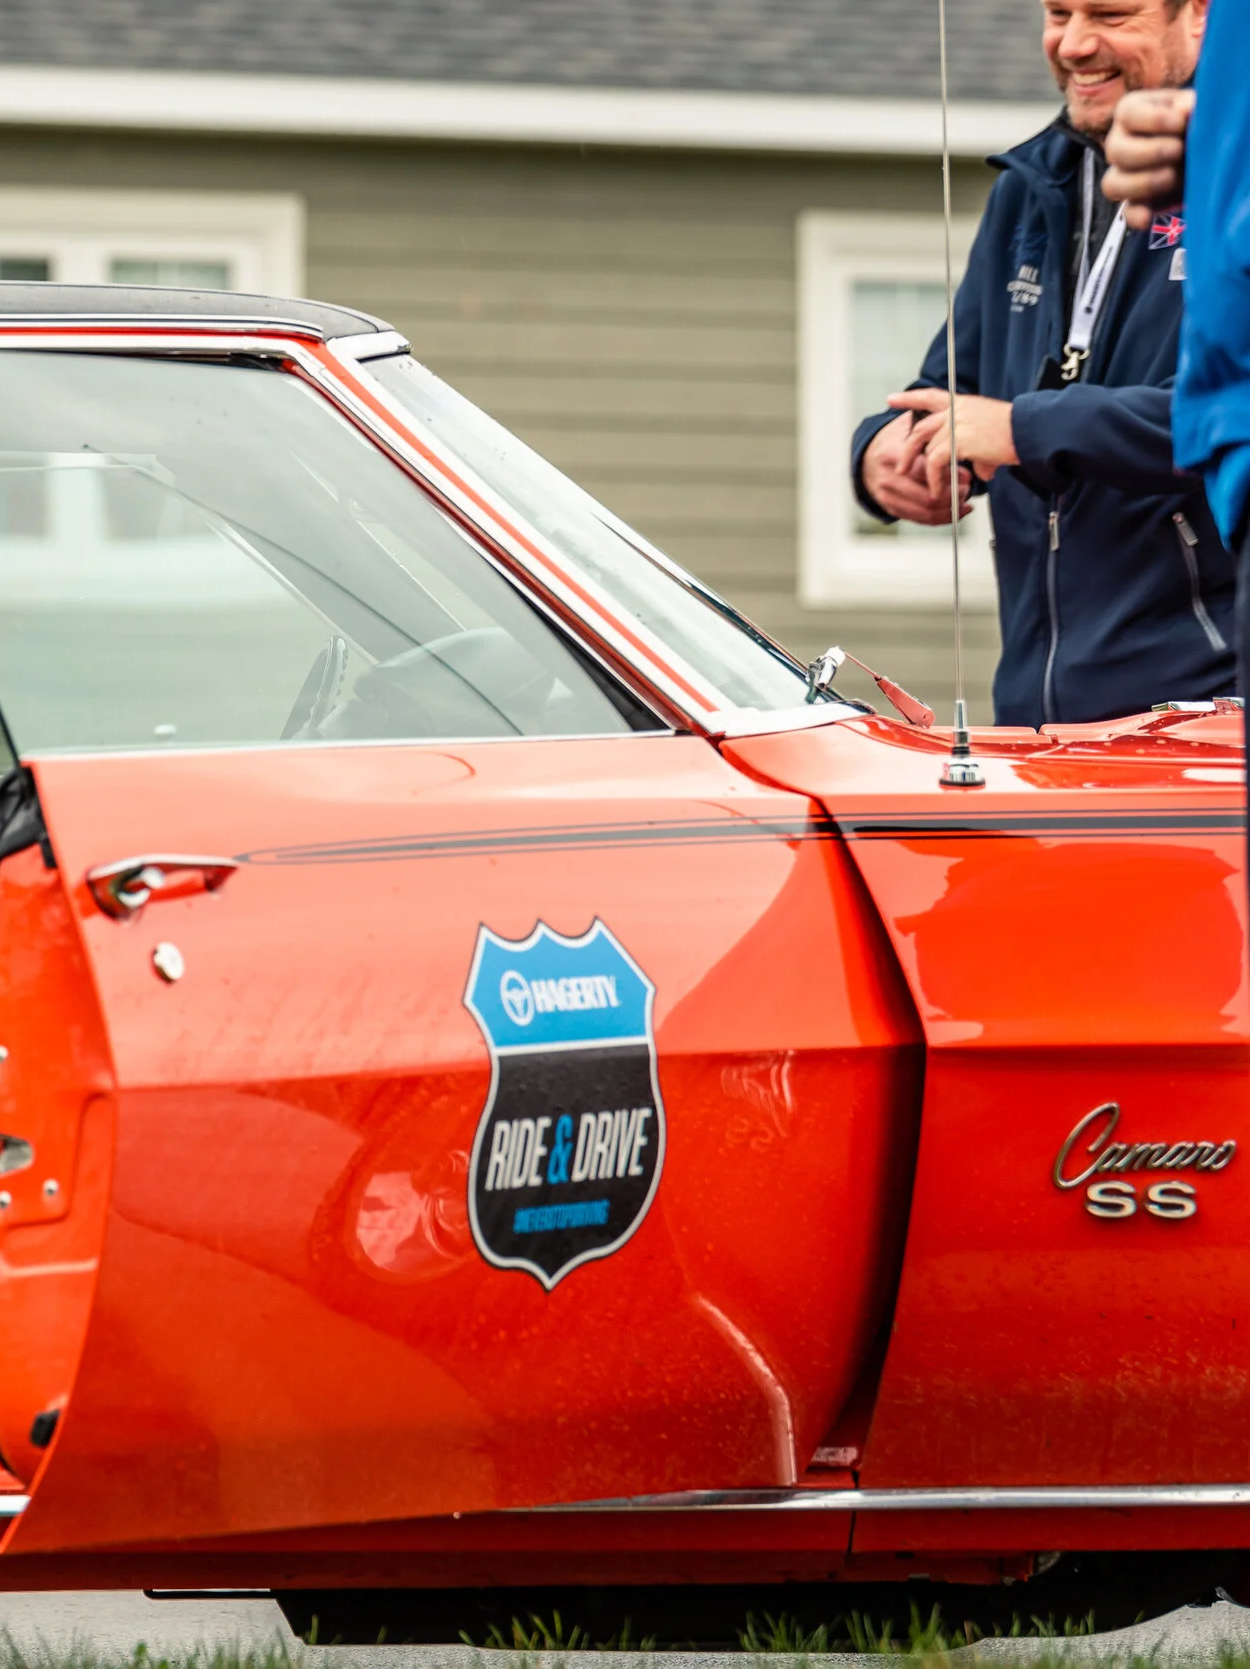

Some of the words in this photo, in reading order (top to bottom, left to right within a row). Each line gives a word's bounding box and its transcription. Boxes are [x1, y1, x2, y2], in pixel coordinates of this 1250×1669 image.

[531, 976, 620, 1013] HAGERTY
[485, 1117, 551, 1191] RIDE
[547, 1114, 573, 1184] &
[571, 1107, 651, 1182] DRIVE
[1054, 1102, 1237, 1188] Camaro
[1086, 1180, 1197, 1219] SS
